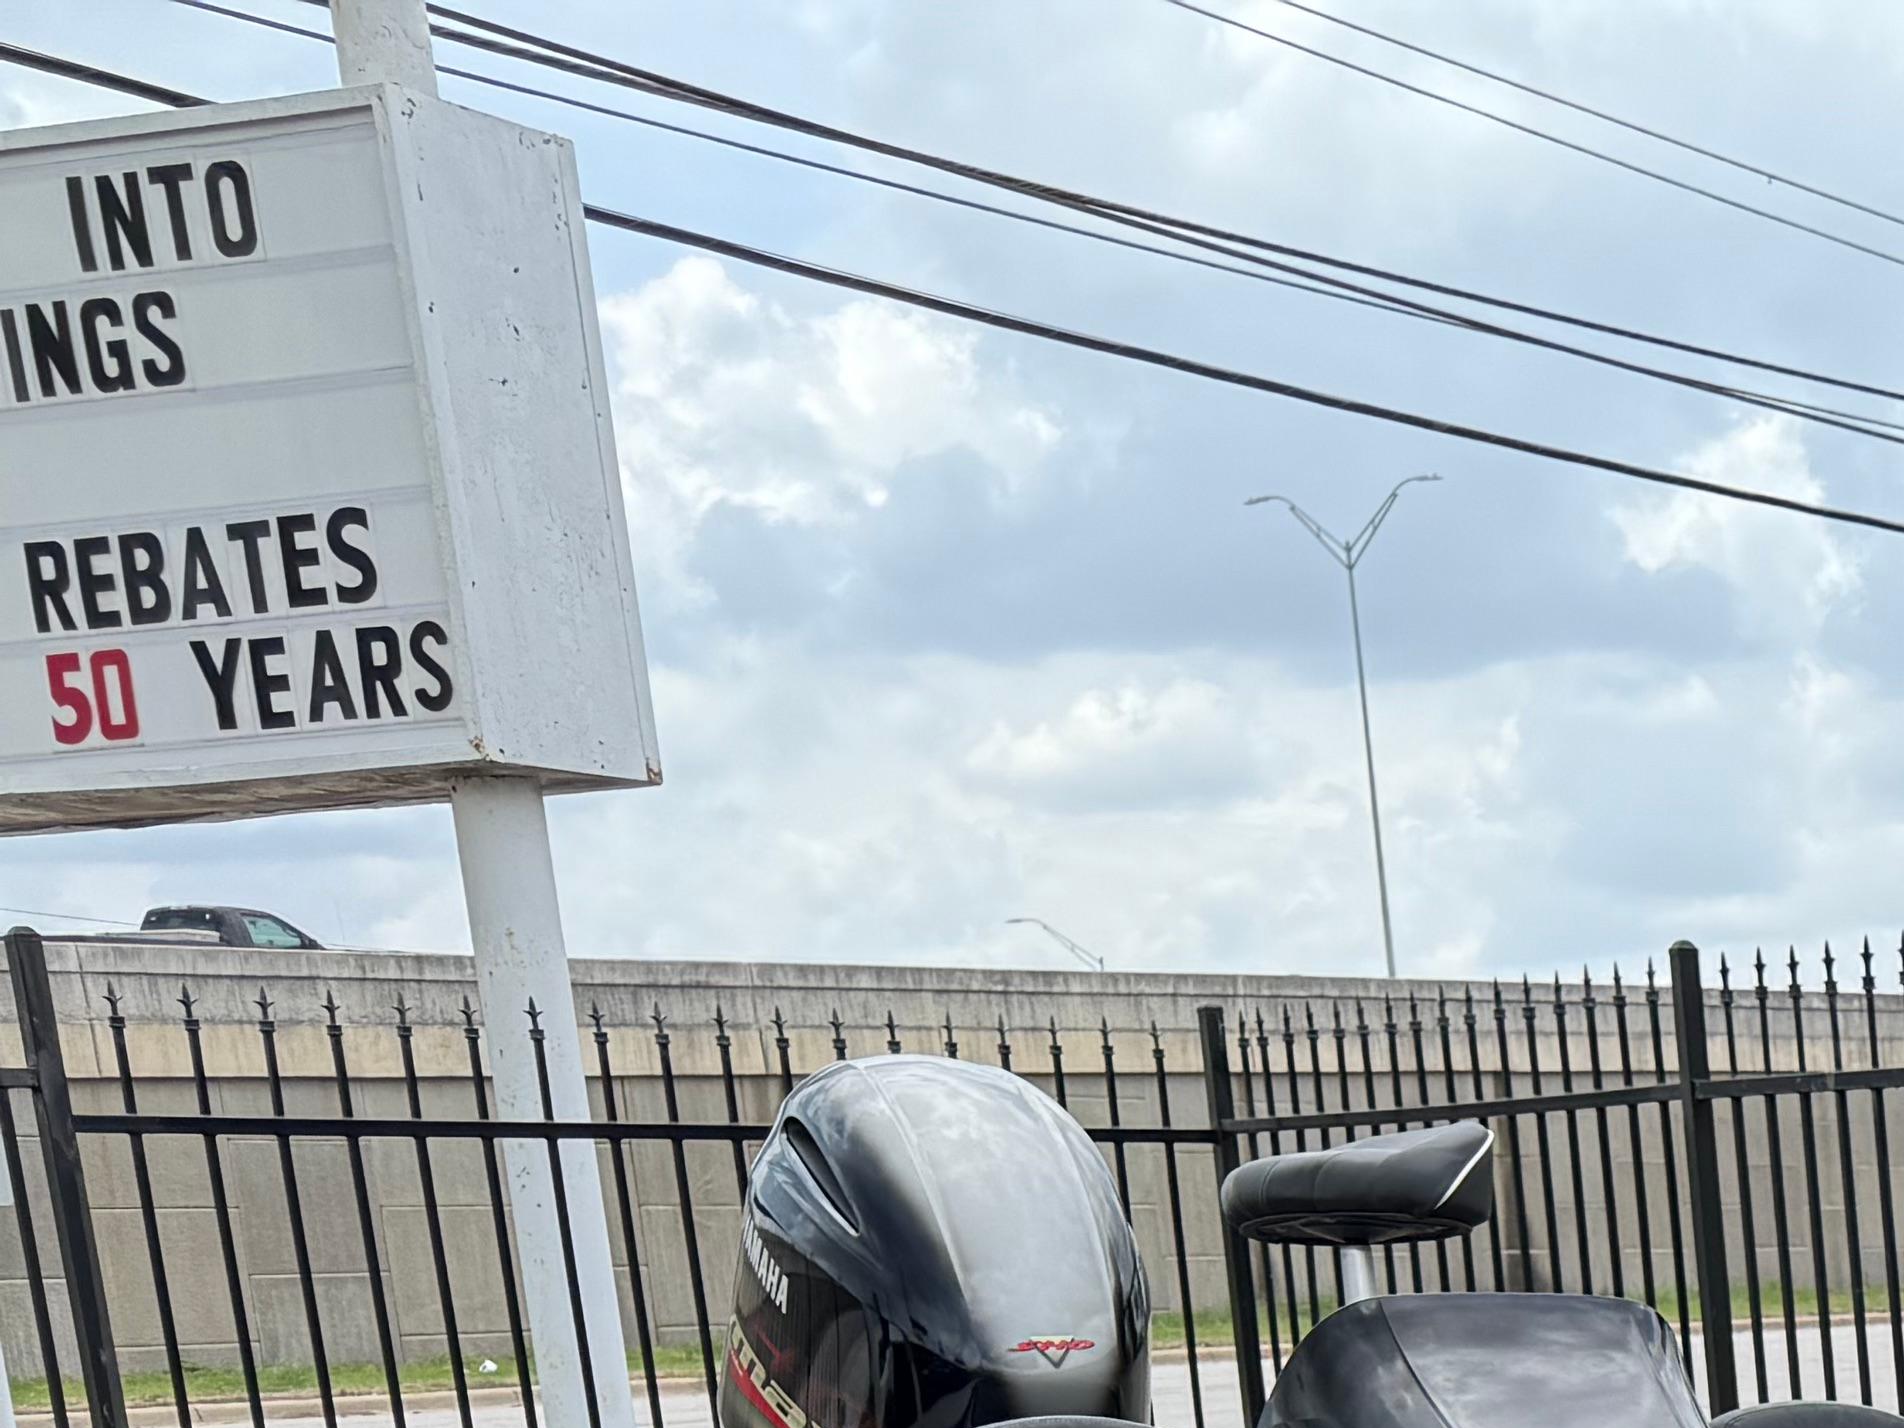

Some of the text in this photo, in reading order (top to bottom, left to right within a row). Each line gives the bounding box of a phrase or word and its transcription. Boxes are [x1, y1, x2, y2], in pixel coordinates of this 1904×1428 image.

[66, 160, 258, 272] INTO
[0, 291, 186, 403] INGS
[24, 507, 378, 633] REBATES
[45, 620, 452, 744] 50 YEARS
